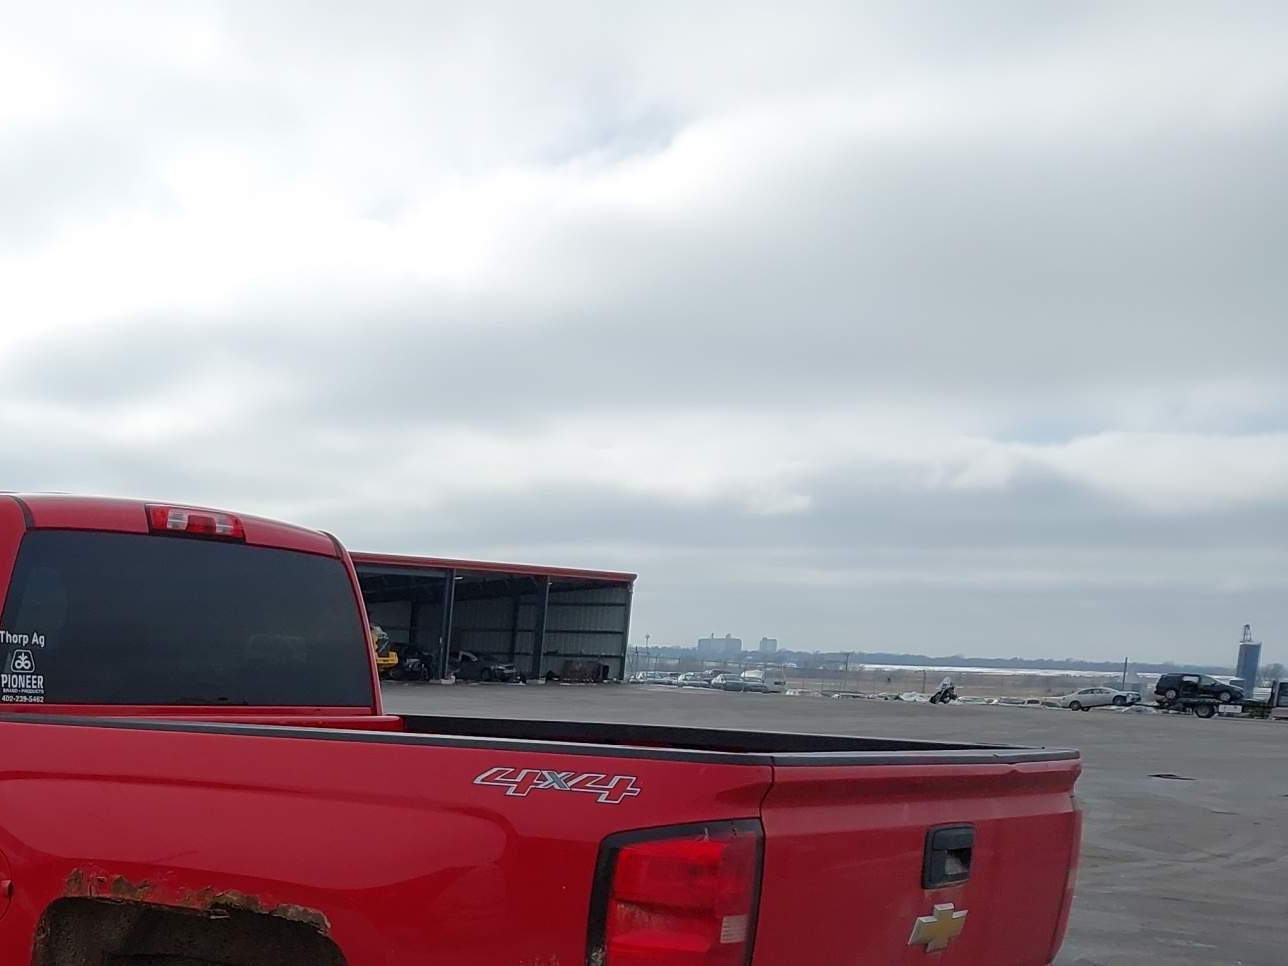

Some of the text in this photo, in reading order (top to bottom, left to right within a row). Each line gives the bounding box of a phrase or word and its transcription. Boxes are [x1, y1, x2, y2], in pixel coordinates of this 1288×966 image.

[0, 630, 45, 647] Thorp Ag
[1, 674, 43, 688] PIONEER
